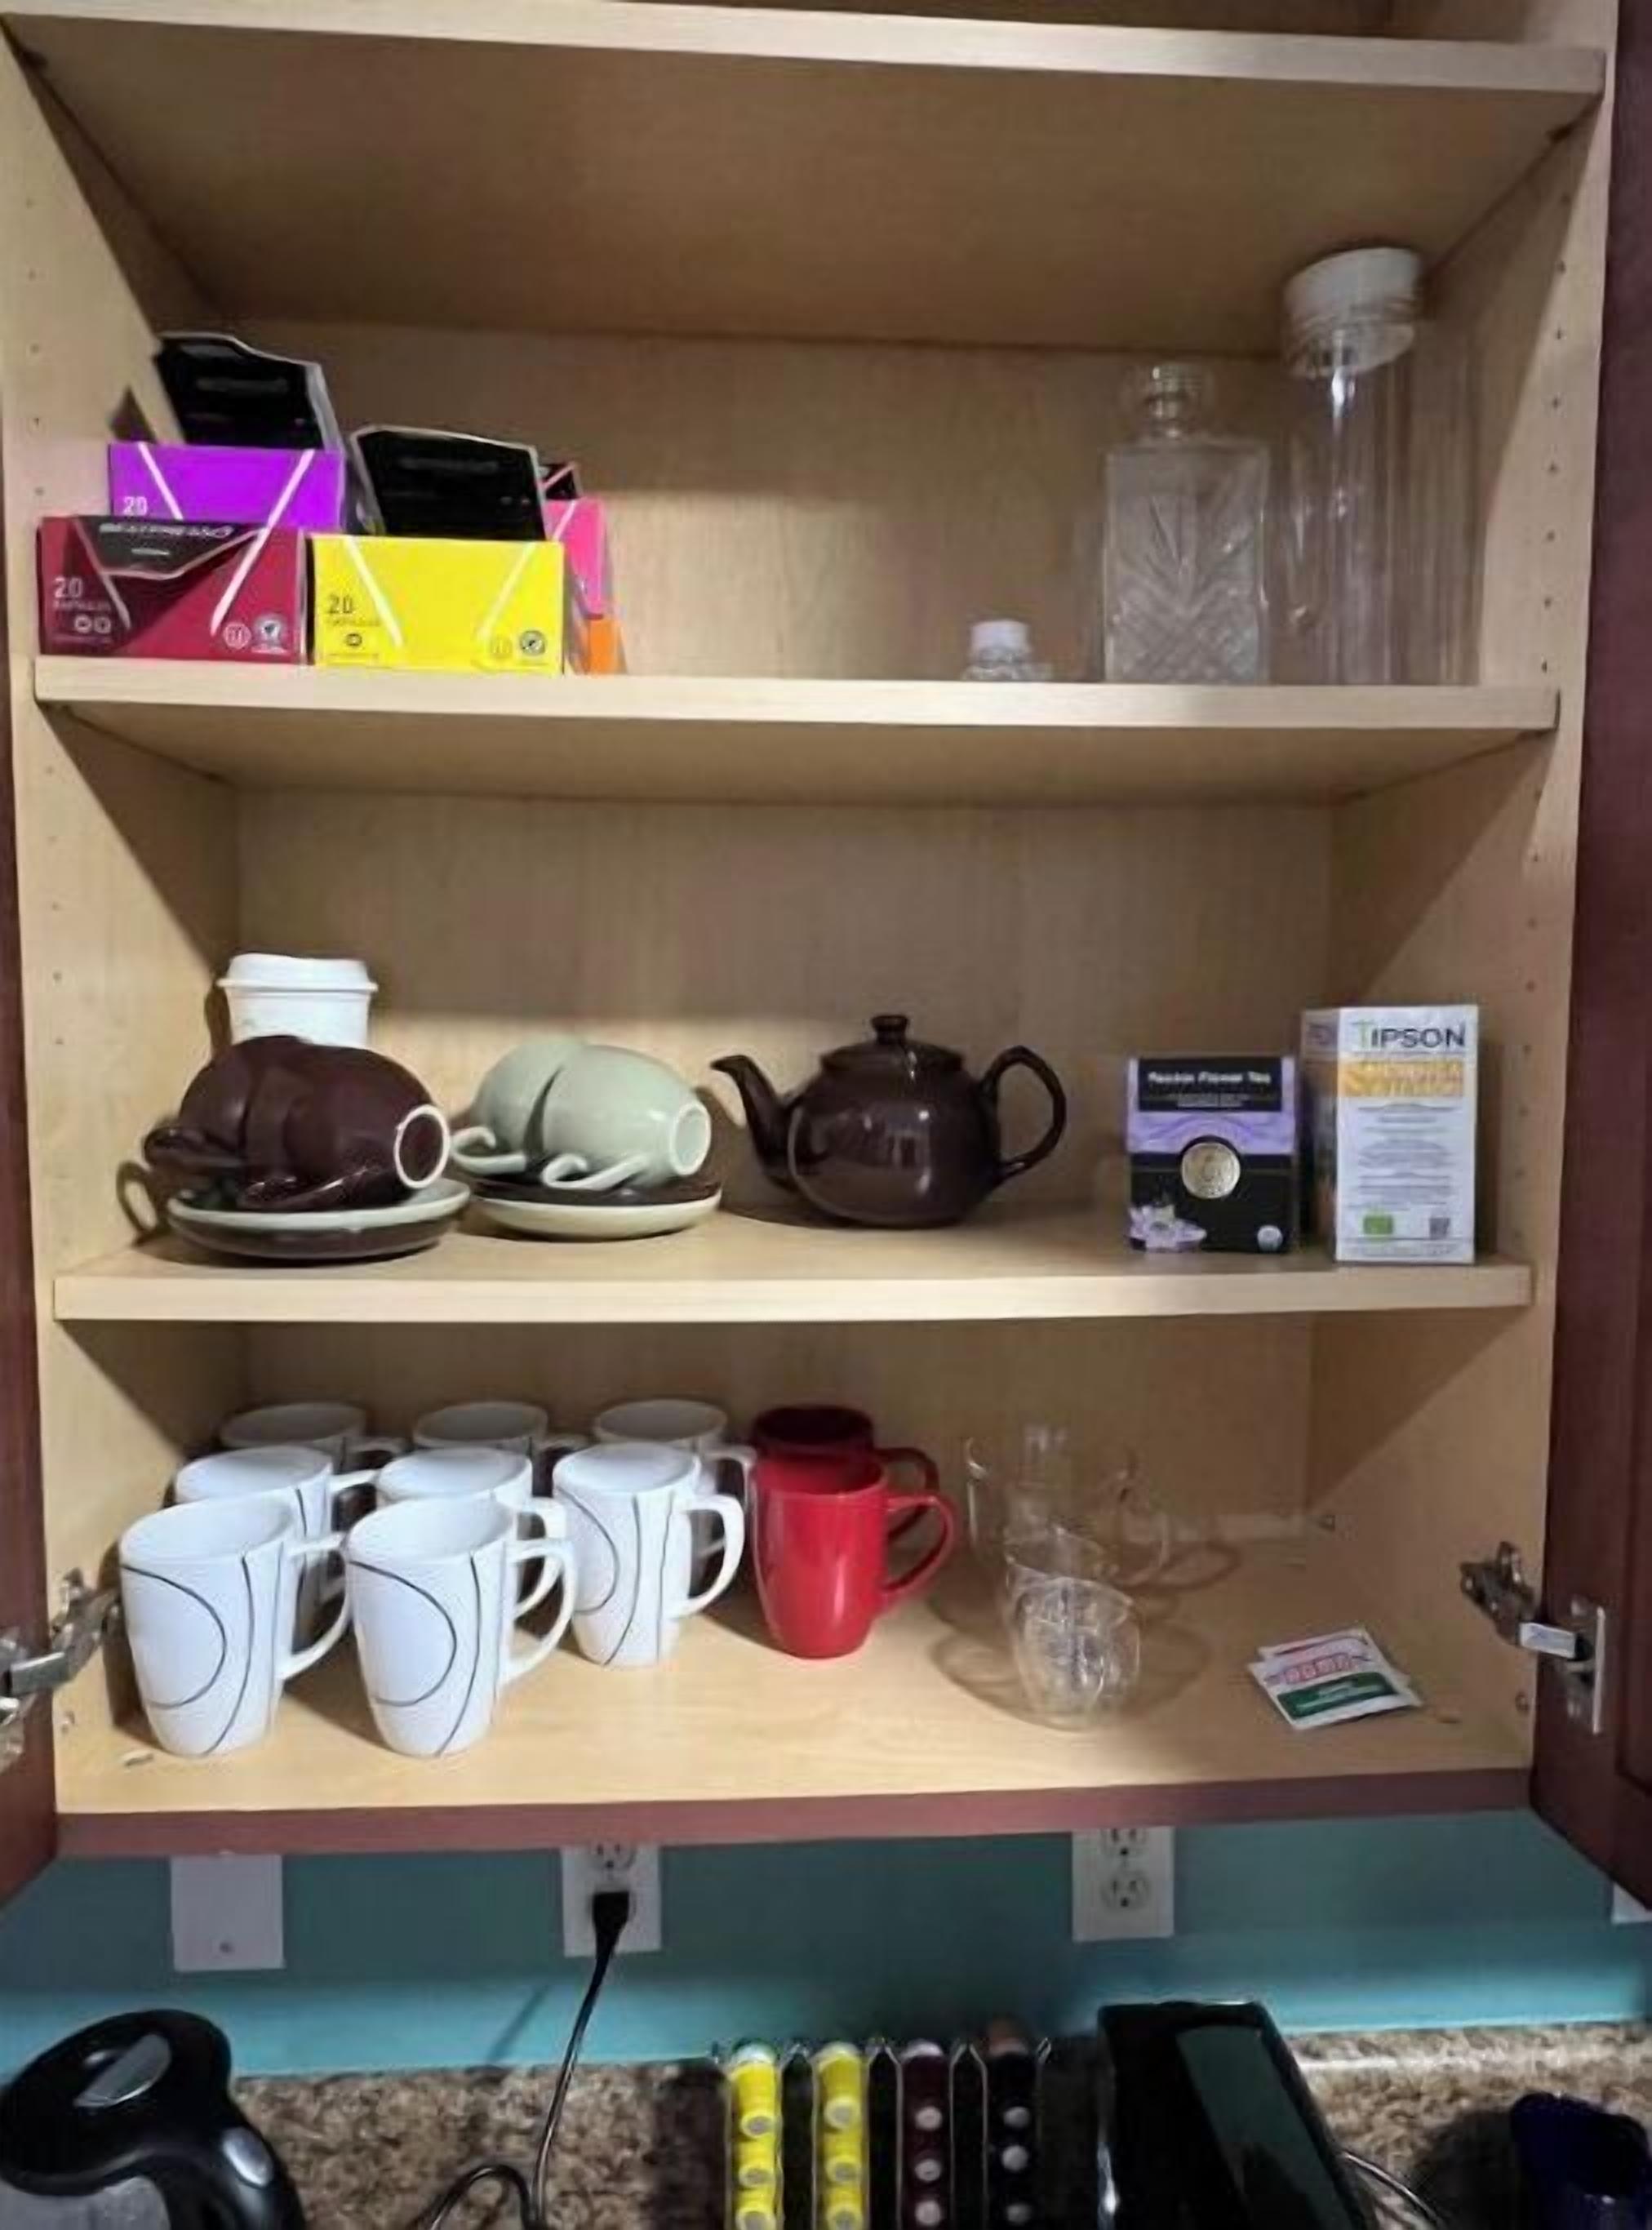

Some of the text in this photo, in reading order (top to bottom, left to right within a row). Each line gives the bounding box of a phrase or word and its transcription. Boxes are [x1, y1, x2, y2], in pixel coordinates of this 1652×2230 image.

[123, 495, 149, 516] 20
[54, 576, 82, 598] 20
[327, 595, 355, 615] 20
[1352, 1019, 1467, 1049] TIPSON
